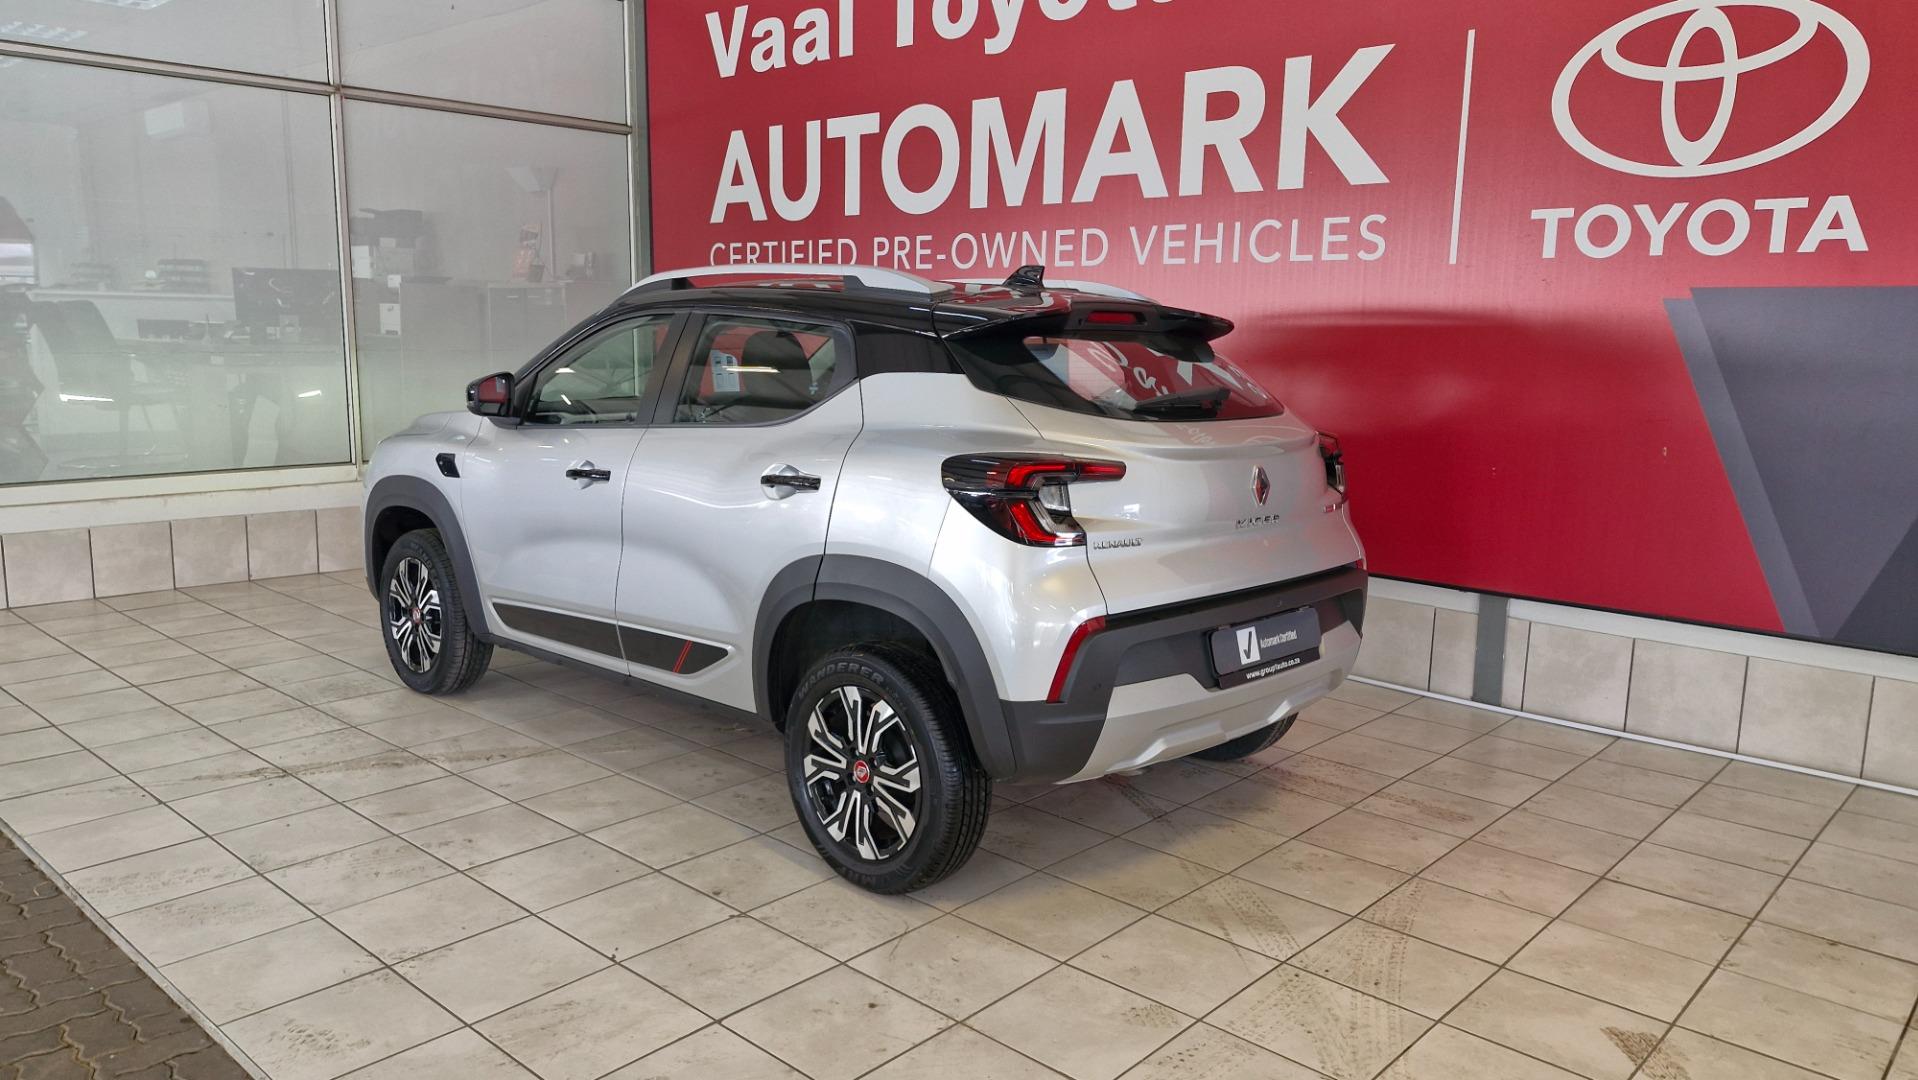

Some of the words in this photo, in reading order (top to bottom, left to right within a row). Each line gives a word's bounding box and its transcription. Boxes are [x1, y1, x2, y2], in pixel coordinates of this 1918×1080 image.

[705, 0, 853, 78] Vaal
[896, 0, 1173, 54] Toy
[710, 44, 1396, 224] AUTOMARK
[710, 238, 858, 267] CERTIFIED
[873, 228, 1109, 270] PRE-OWNED
[1129, 214, 1387, 265] VEHICLES
[1530, 195, 1869, 259] TOYOTA
[1093, 536, 1143, 550] RENAULT
[798, 661, 885, 700] WANDERER
